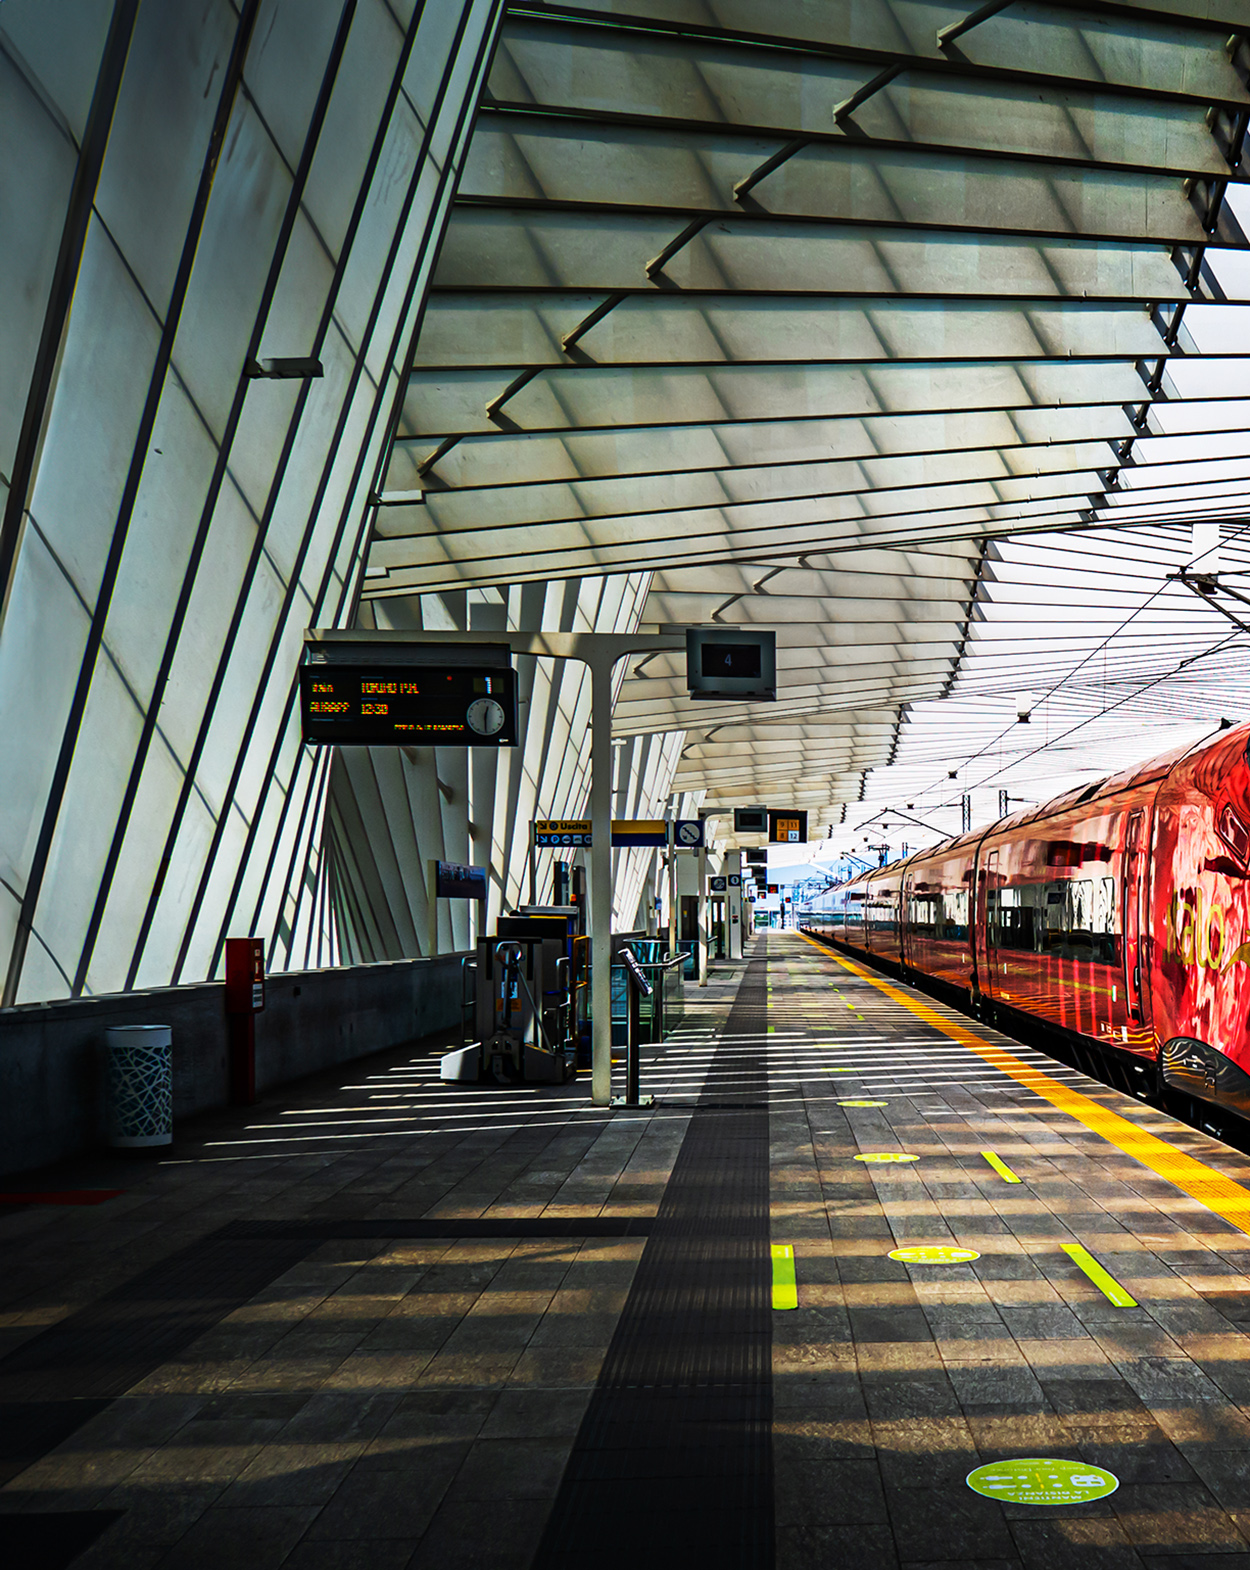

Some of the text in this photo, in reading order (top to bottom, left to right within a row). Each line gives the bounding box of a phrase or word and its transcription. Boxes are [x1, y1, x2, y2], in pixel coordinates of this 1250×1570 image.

[724, 653, 732, 667] 4
[485, 677, 492, 694] 1
[560, 822, 588, 830] Uscita
